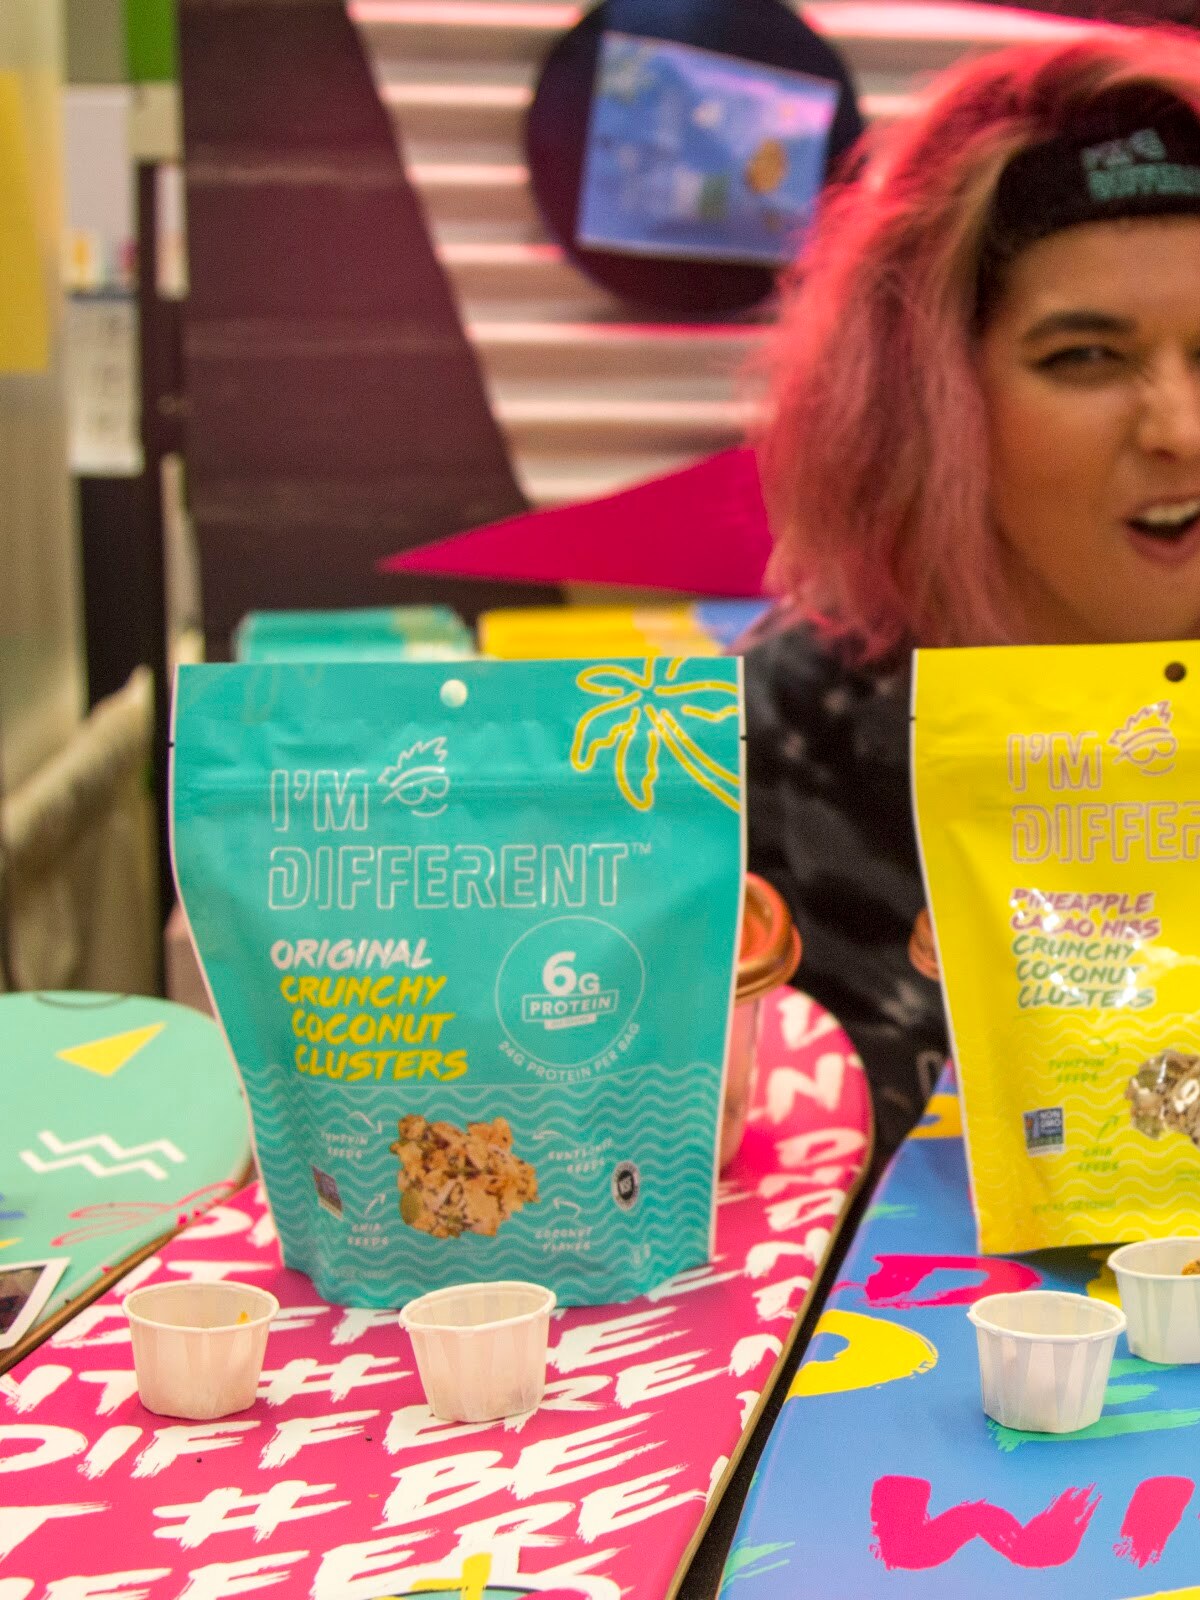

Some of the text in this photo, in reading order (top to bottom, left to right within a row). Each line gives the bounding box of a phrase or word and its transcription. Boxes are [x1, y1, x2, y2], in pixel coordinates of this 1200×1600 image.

[1008, 731, 1103, 793] I'M
[270, 769, 369, 832] I'M
[1012, 911, 1094, 938] CAAO
[270, 938, 433, 970] ORIGINAL
[1012, 934, 1140, 961] CRUNCHY
[542, 951, 600, 996] 6G
[280, 975, 448, 1008] CRUNCHY
[529, 996, 611, 1016] PROTEIN
[1018, 984, 1156, 1009] CLUSTES
[292, 1009, 456, 1045] COCONUT
[295, 1044, 469, 1082] CLUSTERS
